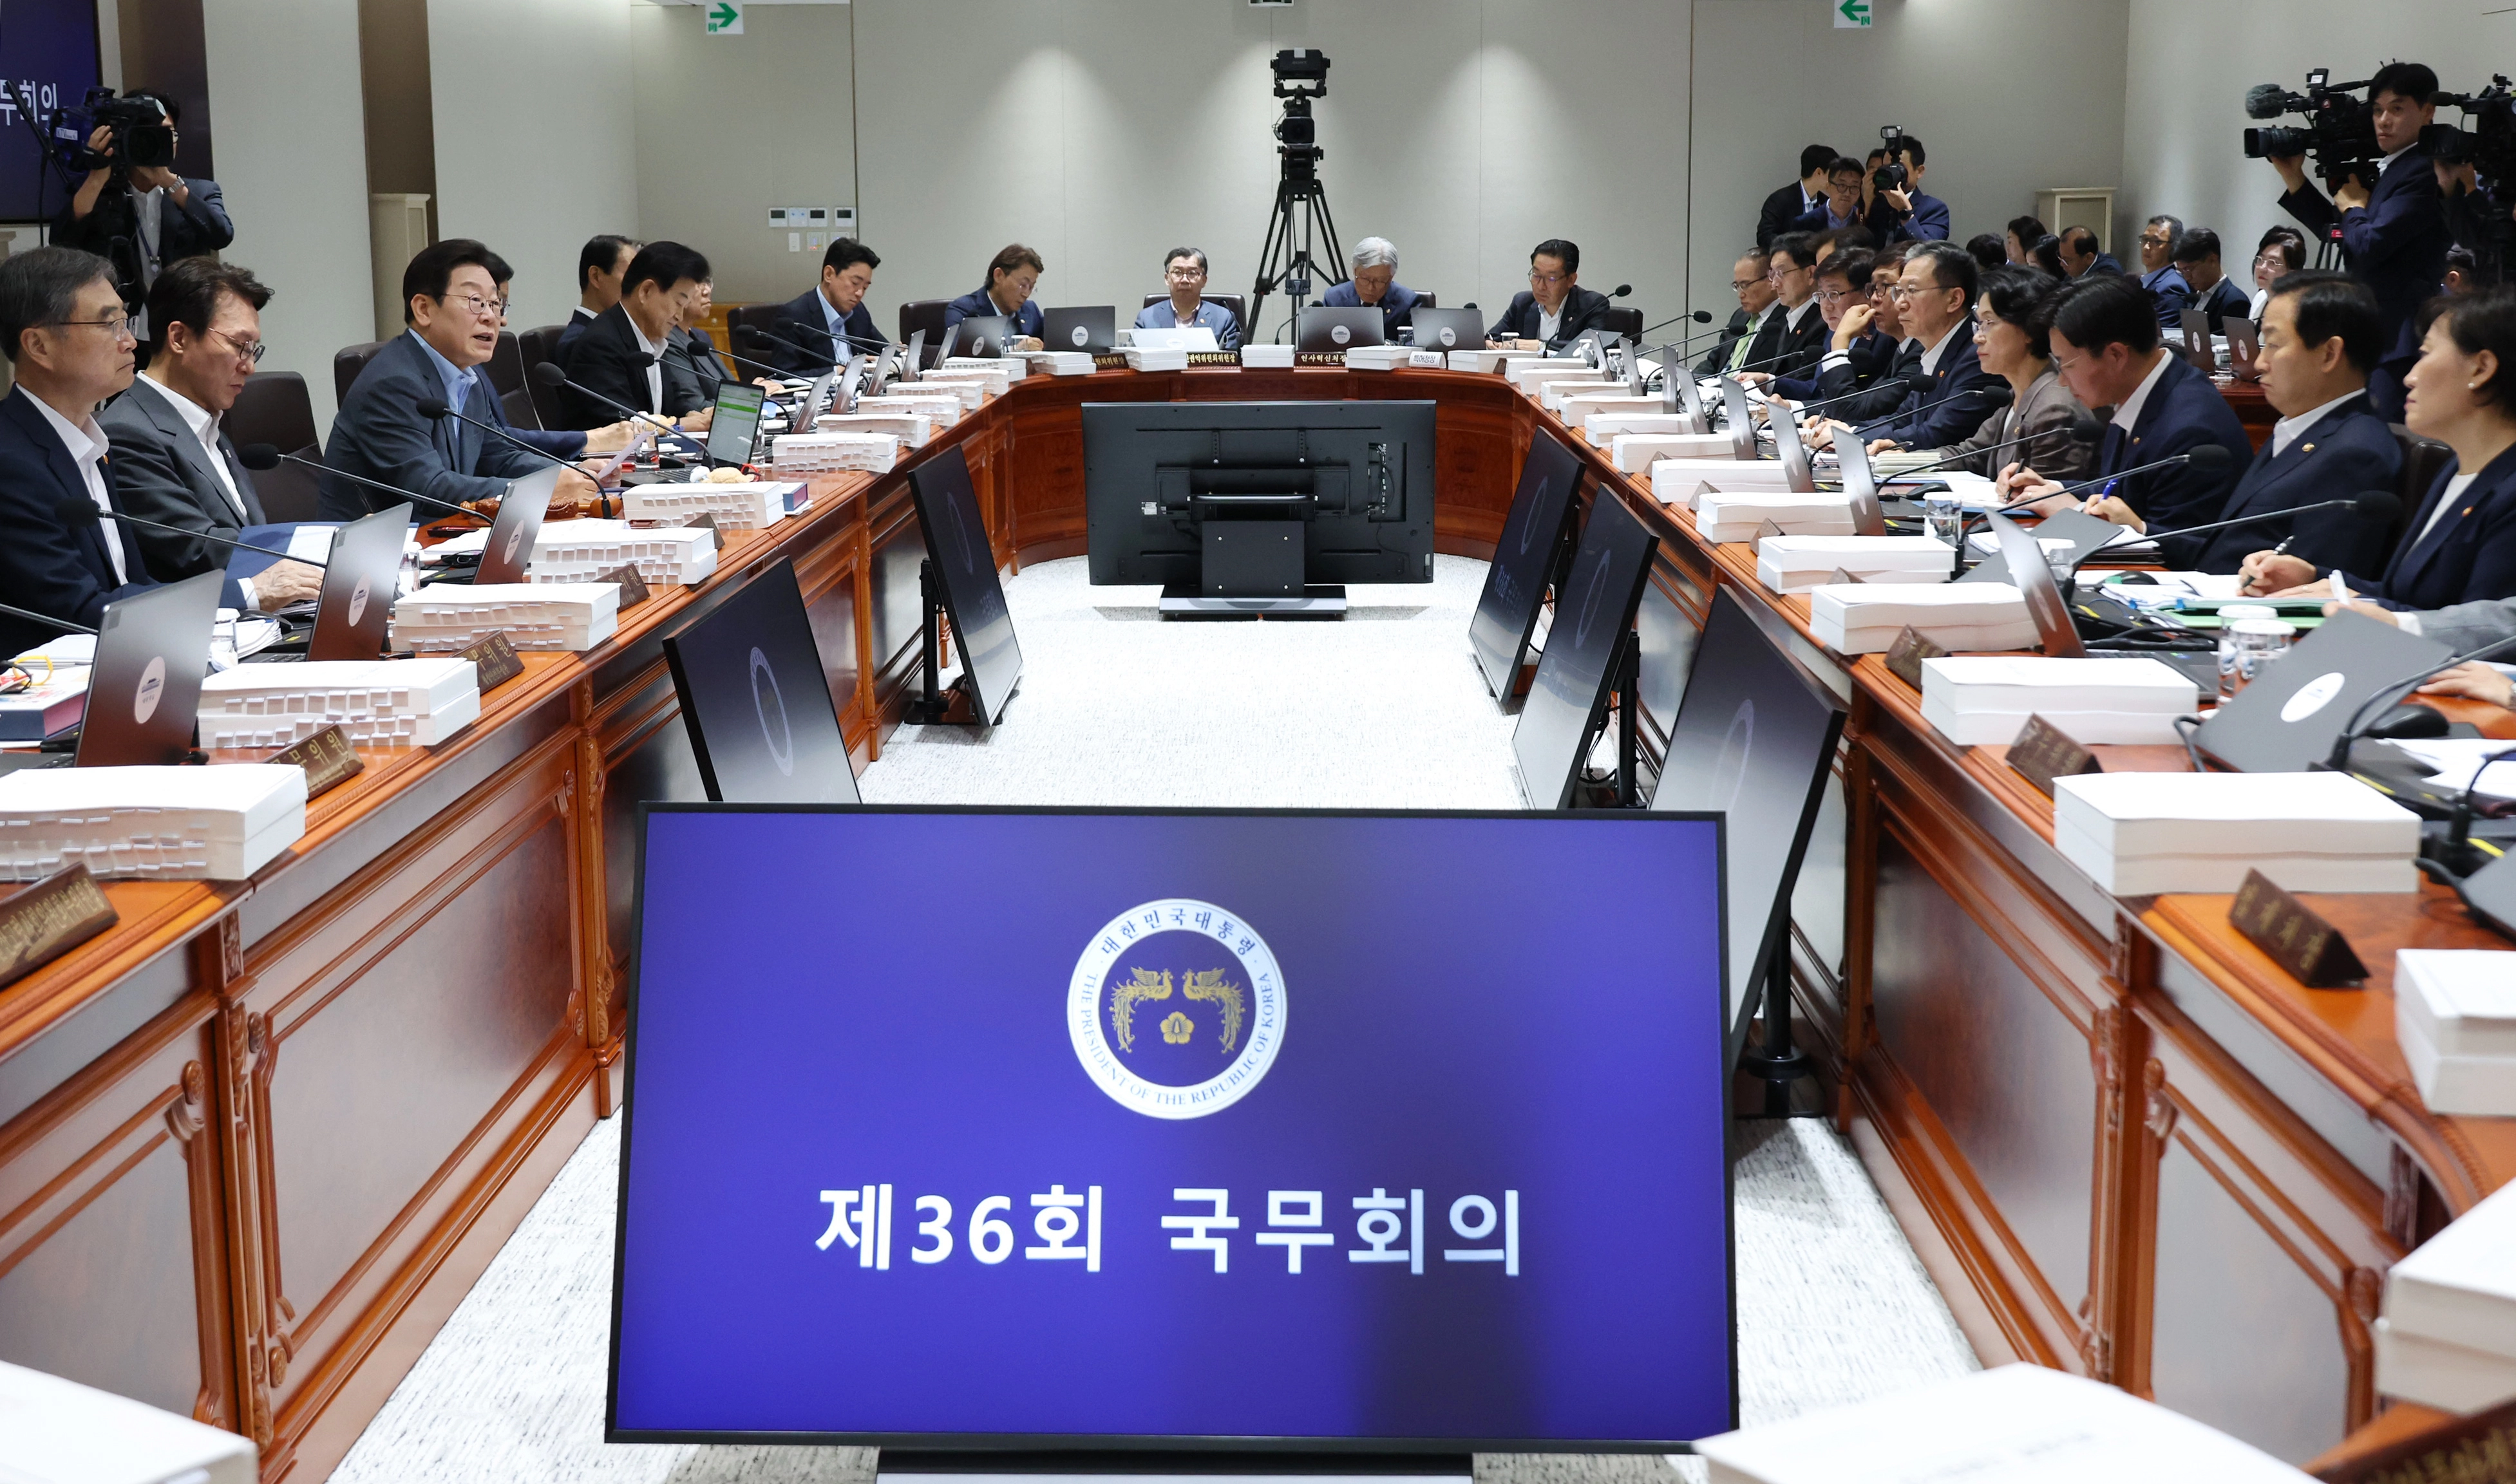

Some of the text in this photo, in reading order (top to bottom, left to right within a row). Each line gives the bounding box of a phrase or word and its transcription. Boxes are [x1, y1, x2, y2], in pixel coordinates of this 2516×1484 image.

[1092, 356, 1124, 366] 원회위원장
[1301, 353, 1347, 362] 인사혁신처장
[1414, 355, 1436, 364] 특허청장
[270, 730, 348, 775] 무위원
[1101, 908, 1256, 955] 대한민국대통령
[1081, 973, 1274, 1105] THE PRESIDENT OF THE REPUBLIC OF KOREA
[816, 1183, 1520, 1277] 제36회 국무회의
